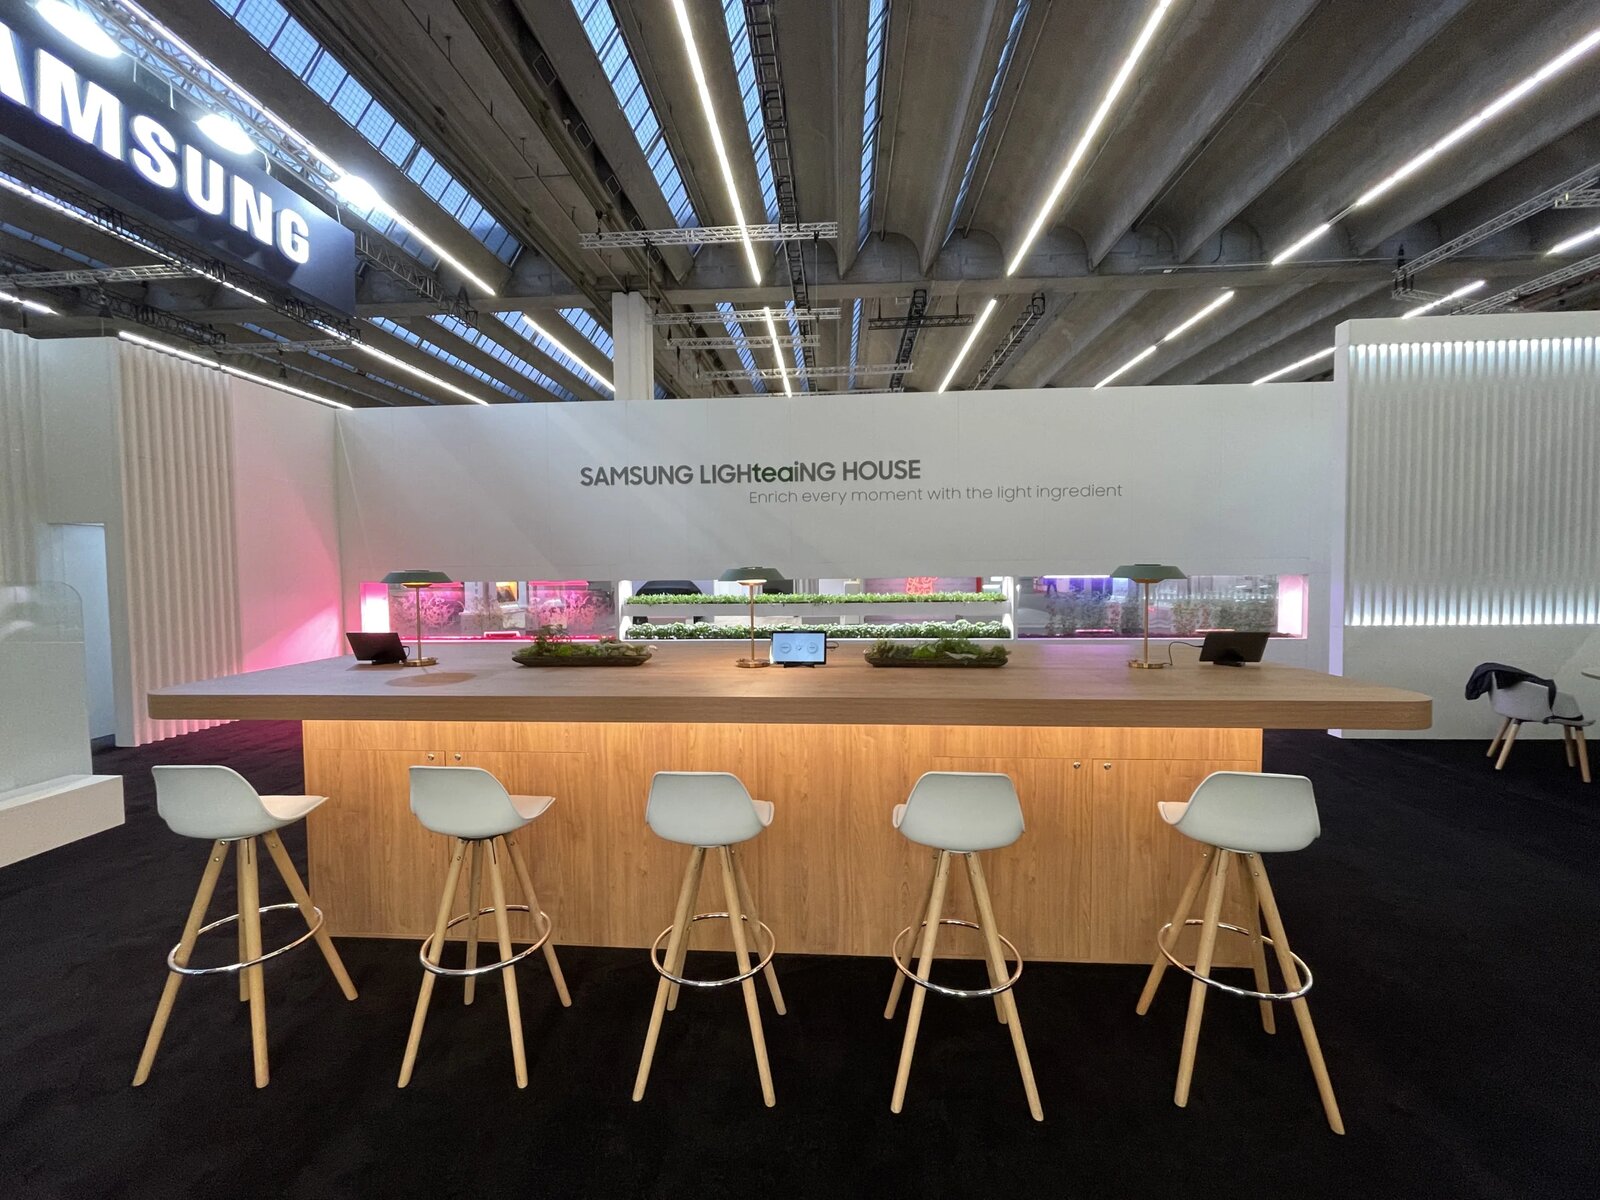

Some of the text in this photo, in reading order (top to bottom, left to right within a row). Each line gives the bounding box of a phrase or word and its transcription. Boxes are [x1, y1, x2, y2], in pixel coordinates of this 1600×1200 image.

[580, 459, 921, 486] SAMSUNG LIGHteaiNG HOUSE
[749, 483, 1123, 505] Enrich every moment with the light ingredient
